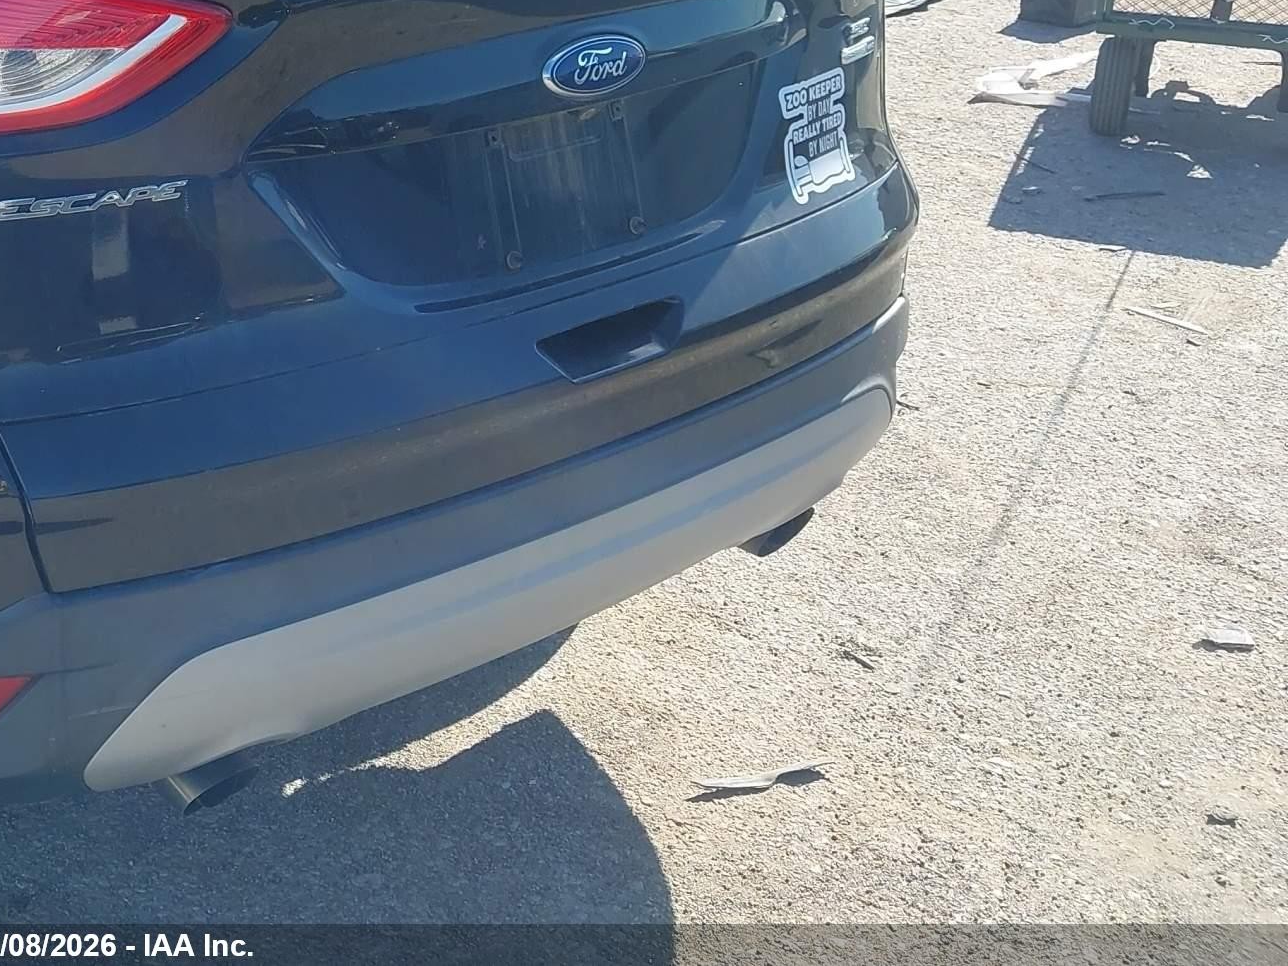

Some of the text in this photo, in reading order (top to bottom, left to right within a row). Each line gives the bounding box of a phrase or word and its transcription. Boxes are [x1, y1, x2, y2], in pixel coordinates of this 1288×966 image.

[574, 47, 627, 85] Ford
[785, 75, 842, 110] ZOO KEEPER
[807, 98, 831, 122] BY DAY
[793, 111, 842, 146] REALLY TIRED
[809, 130, 839, 158] BY NIGHT
